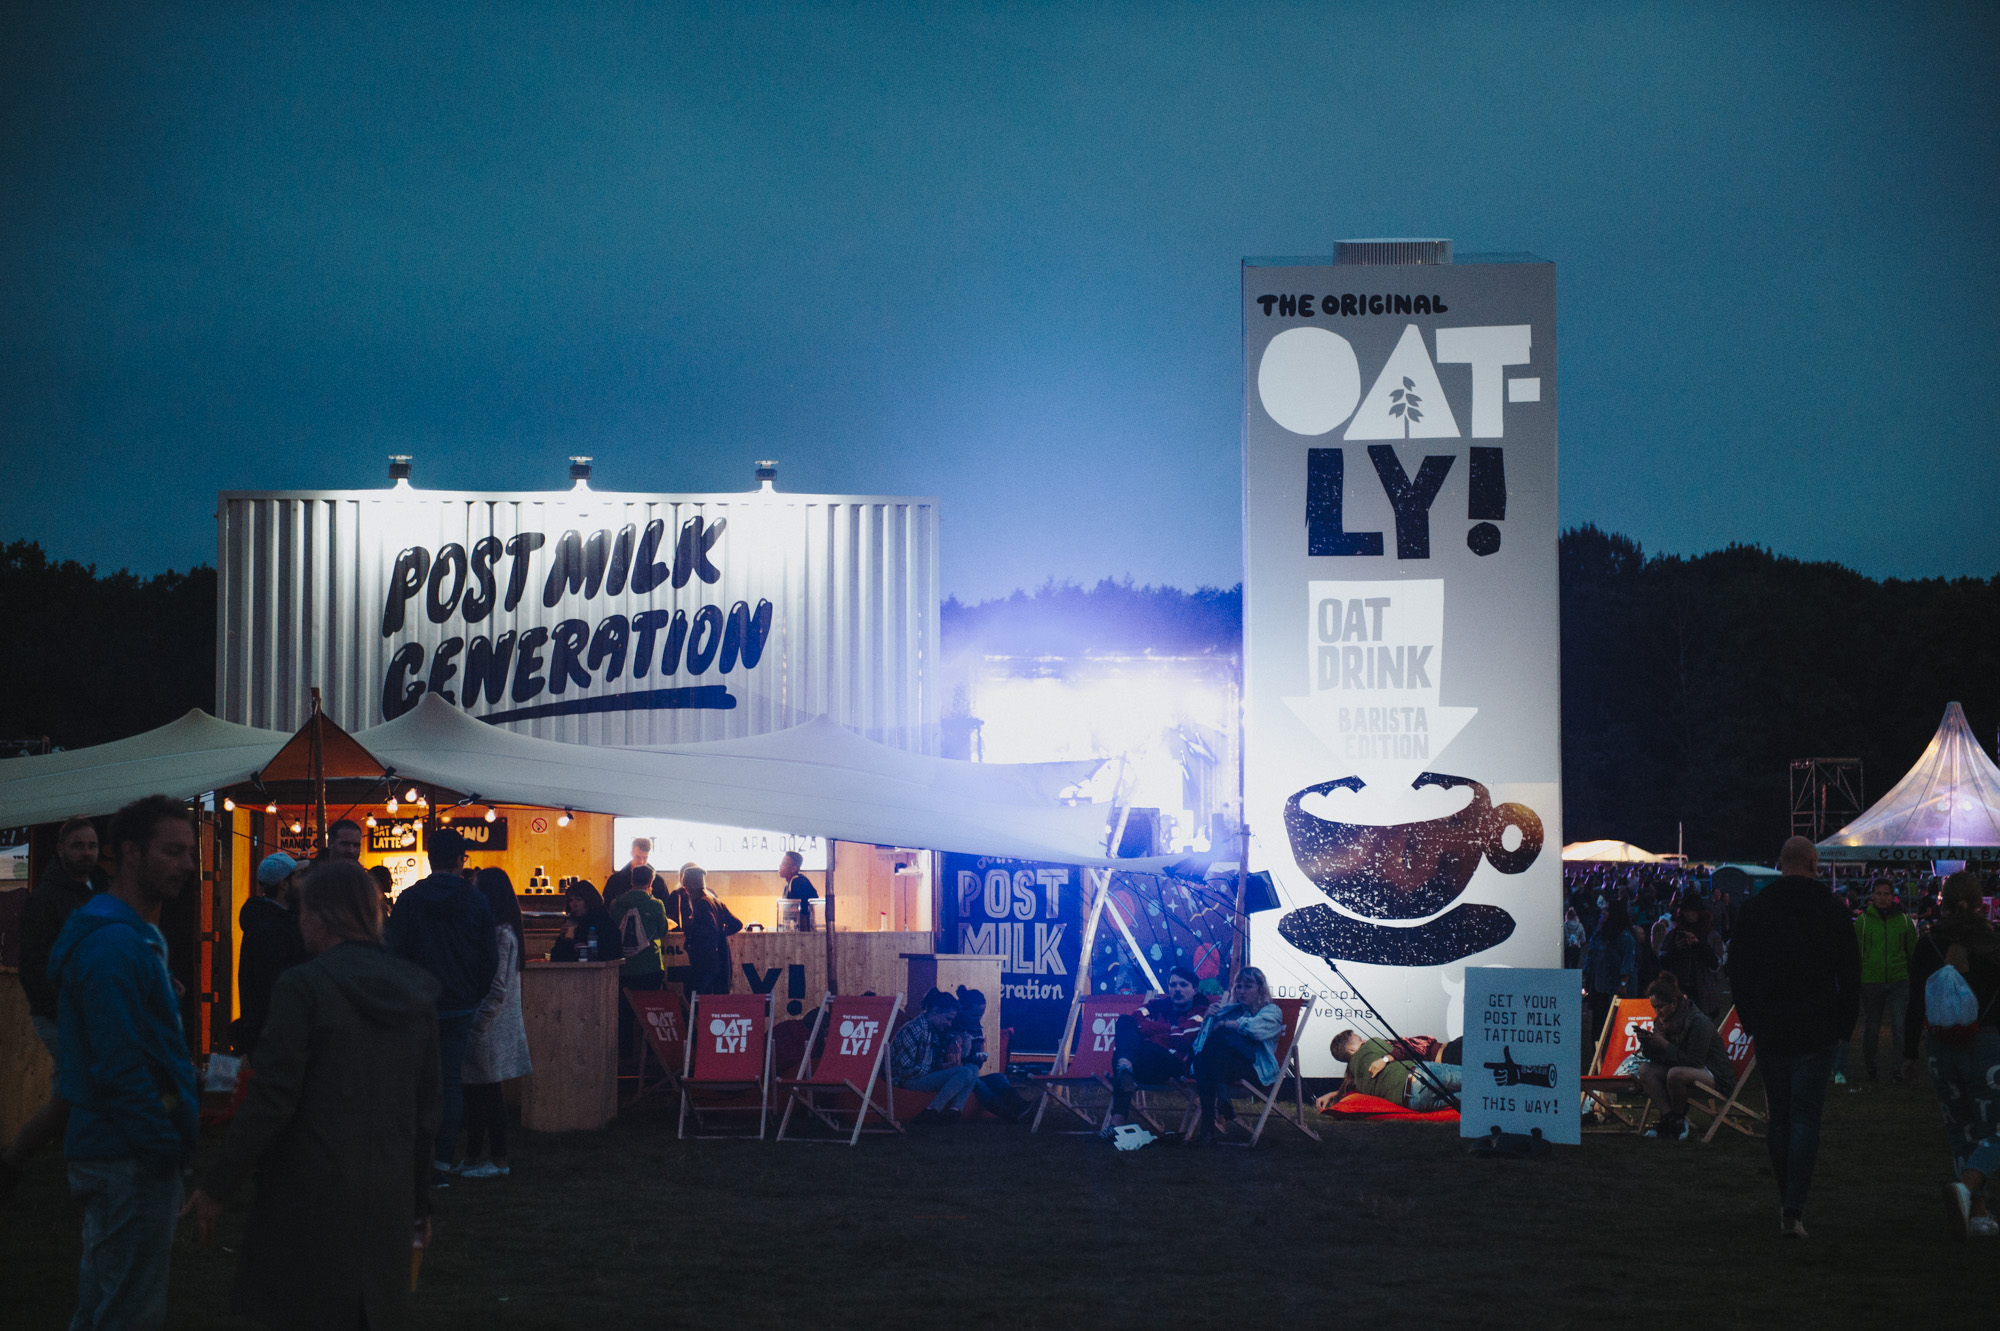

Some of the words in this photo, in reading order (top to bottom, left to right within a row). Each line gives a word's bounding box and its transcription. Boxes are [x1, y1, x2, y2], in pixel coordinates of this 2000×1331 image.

[1257, 294, 1314, 317] THE
[1321, 294, 1448, 316] ORIGINAL
[1258, 323, 1541, 440] OAT-
[1305, 444, 1507, 559] LY!
[382, 532, 546, 638] POST
[543, 515, 727, 608] MILK
[1317, 597, 1391, 643] OAT
[382, 598, 773, 722] GENERATION
[1317, 645, 1434, 691] DRINK
[1339, 706, 1428, 733] BARISTA
[1345, 734, 1429, 760] EDITION
[373, 837, 401, 848] LATTE
[957, 869, 1069, 920] POST
[957, 922, 1068, 975] MILK
[1001, 978, 1064, 1000] eration
[1320, 990, 1359, 1000] cool
[1489, 994, 1513, 1008] GET
[1523, 995, 1557, 1009] YOUR
[1315, 1008, 1373, 1020] vegans
[1484, 1011, 1517, 1025] POST
[1527, 1012, 1561, 1027] MILK
[655, 1026, 679, 1042] LY!
[716, 1037, 747, 1053] LY!
[1093, 1036, 1116, 1051] LY
[1484, 1028, 1561, 1044] TATTOOATS
[840, 1038, 871, 1055] LY!
[1482, 1097, 1516, 1112] THIS
[1525, 1099, 1559, 1115] WAY!
